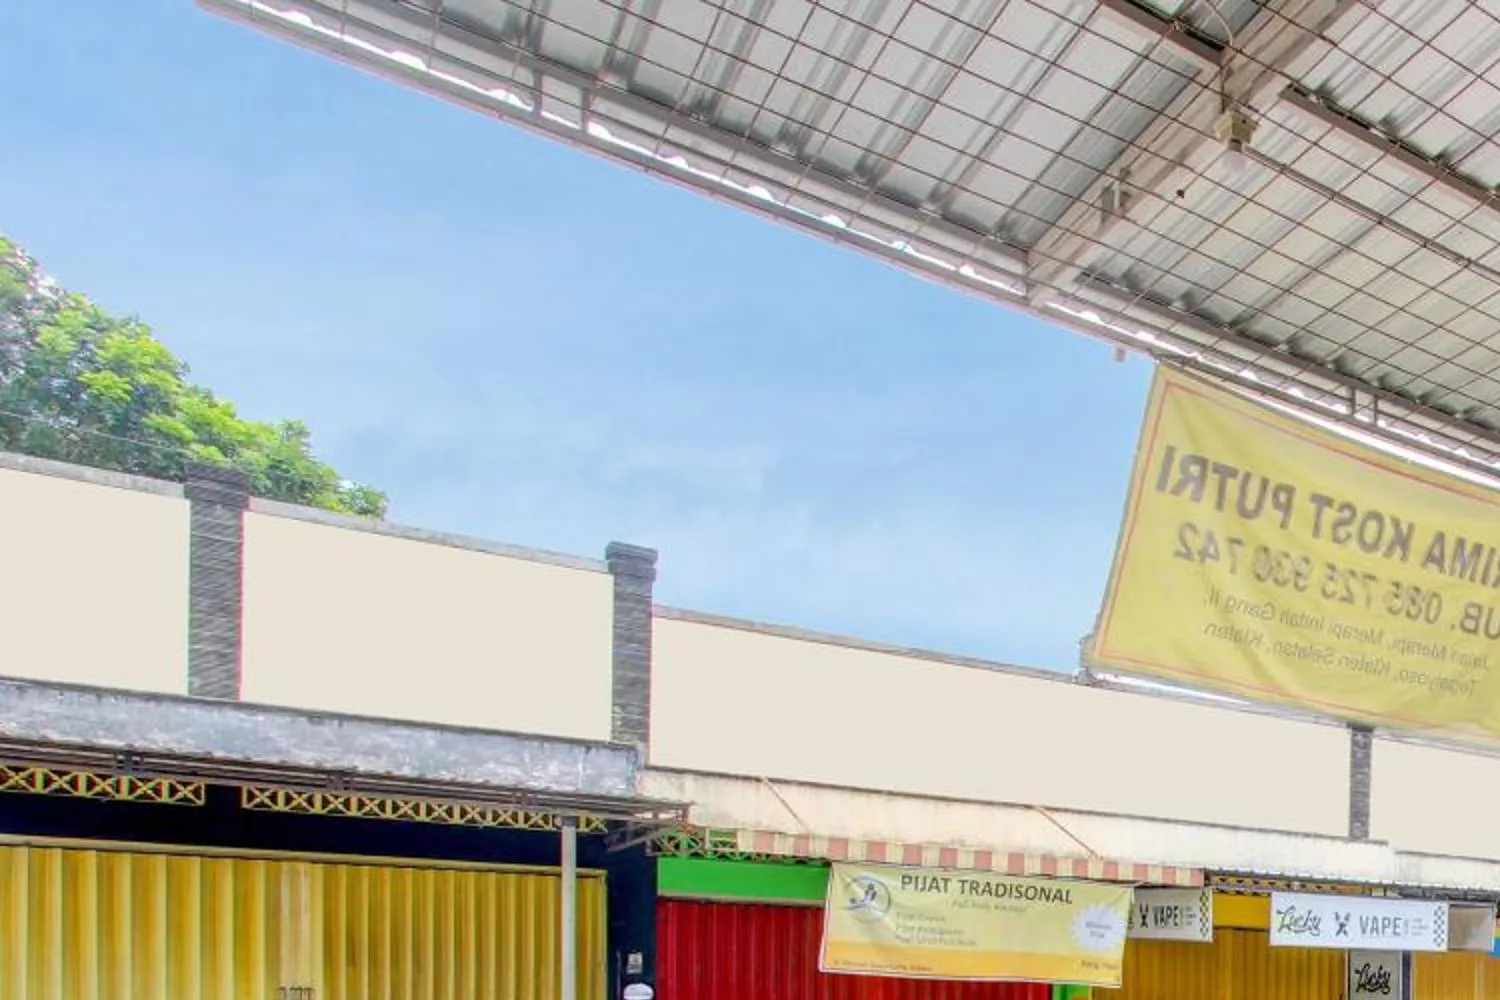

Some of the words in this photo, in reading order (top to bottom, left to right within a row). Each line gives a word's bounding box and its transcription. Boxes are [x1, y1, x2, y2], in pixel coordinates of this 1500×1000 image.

[900, 874, 952, 894] PIJAT
[958, 878, 1074, 905] TRADISONAL
[1359, 915, 1402, 937] VAPE
